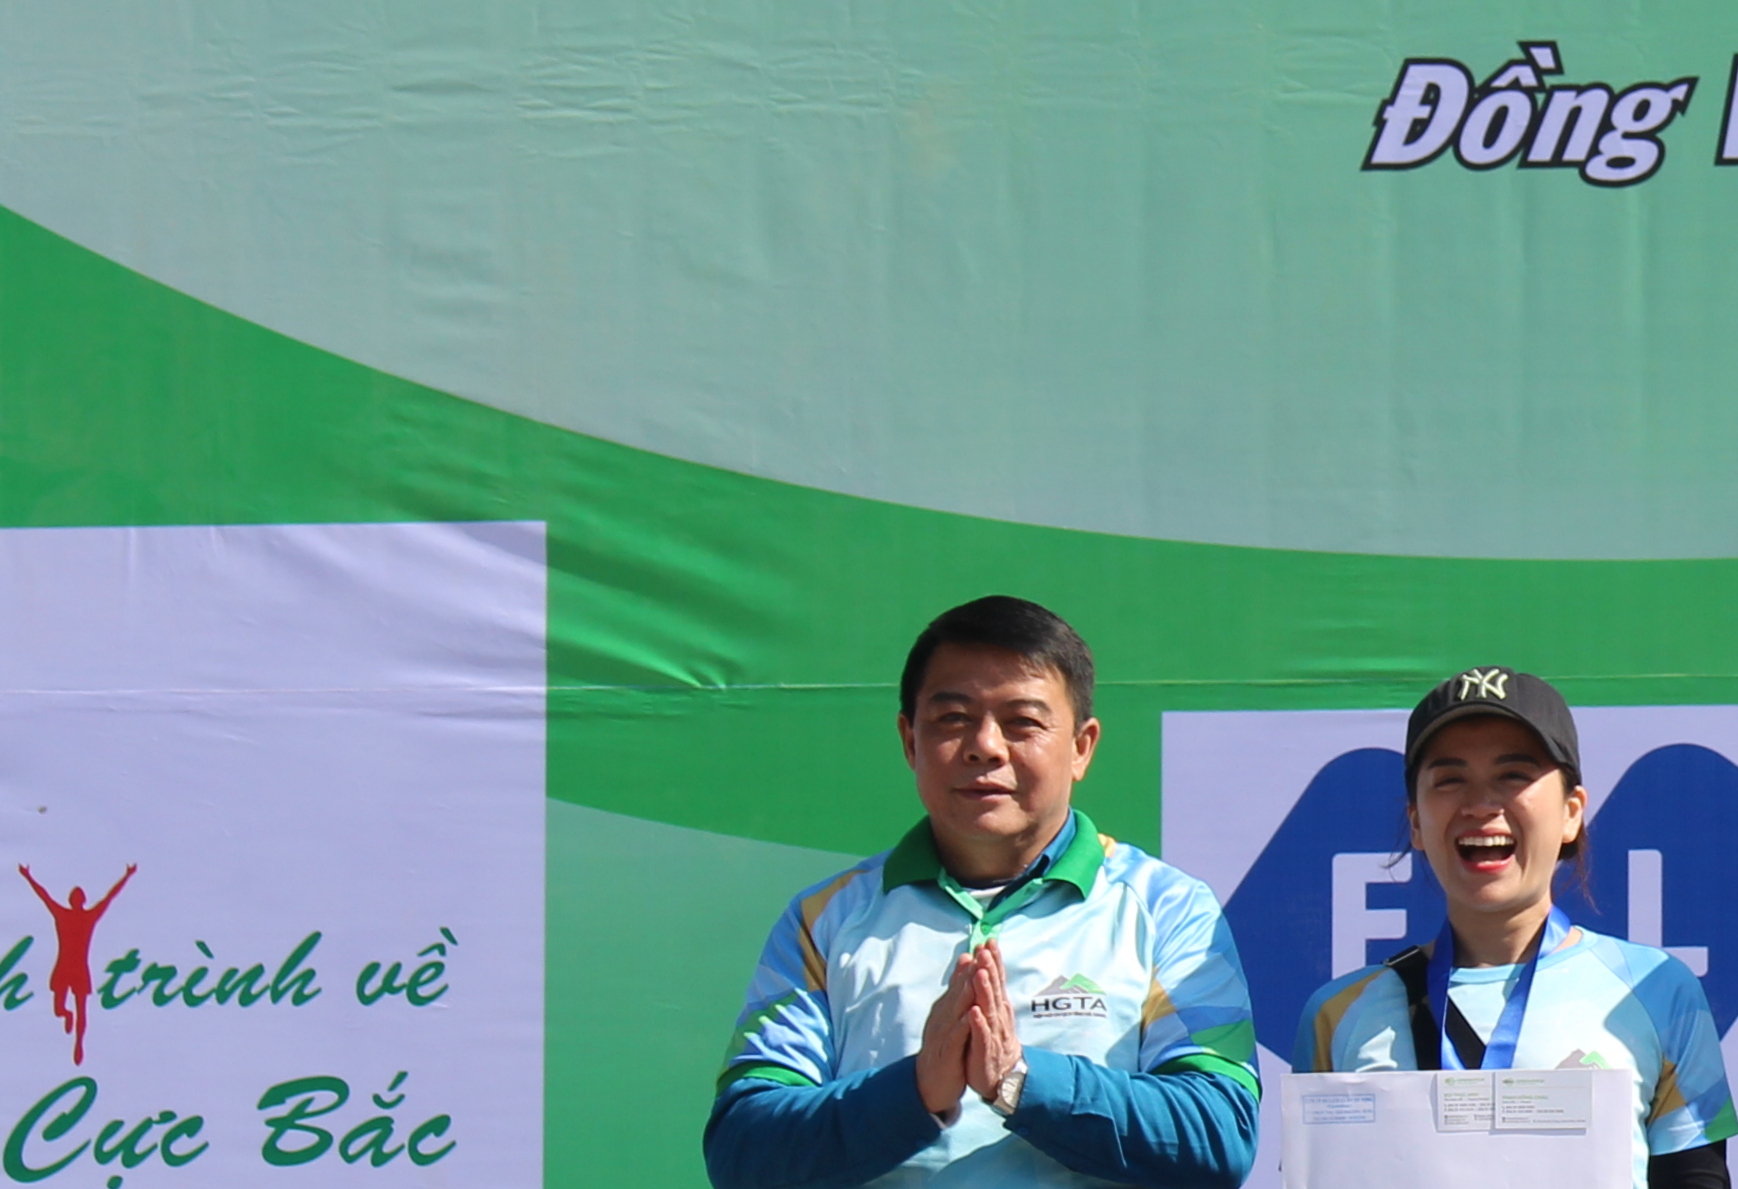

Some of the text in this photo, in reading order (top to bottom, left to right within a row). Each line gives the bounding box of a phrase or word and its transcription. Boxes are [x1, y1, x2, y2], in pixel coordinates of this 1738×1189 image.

[1362, 40, 1698, 186] Đồng
[1458, 668, 1509, 700] NY
[97, 931, 322, 1010] trình
[356, 927, 458, 1007] về
[1031, 996, 1107, 1012] HGTA
[256, 1071, 456, 1167] Bắc
